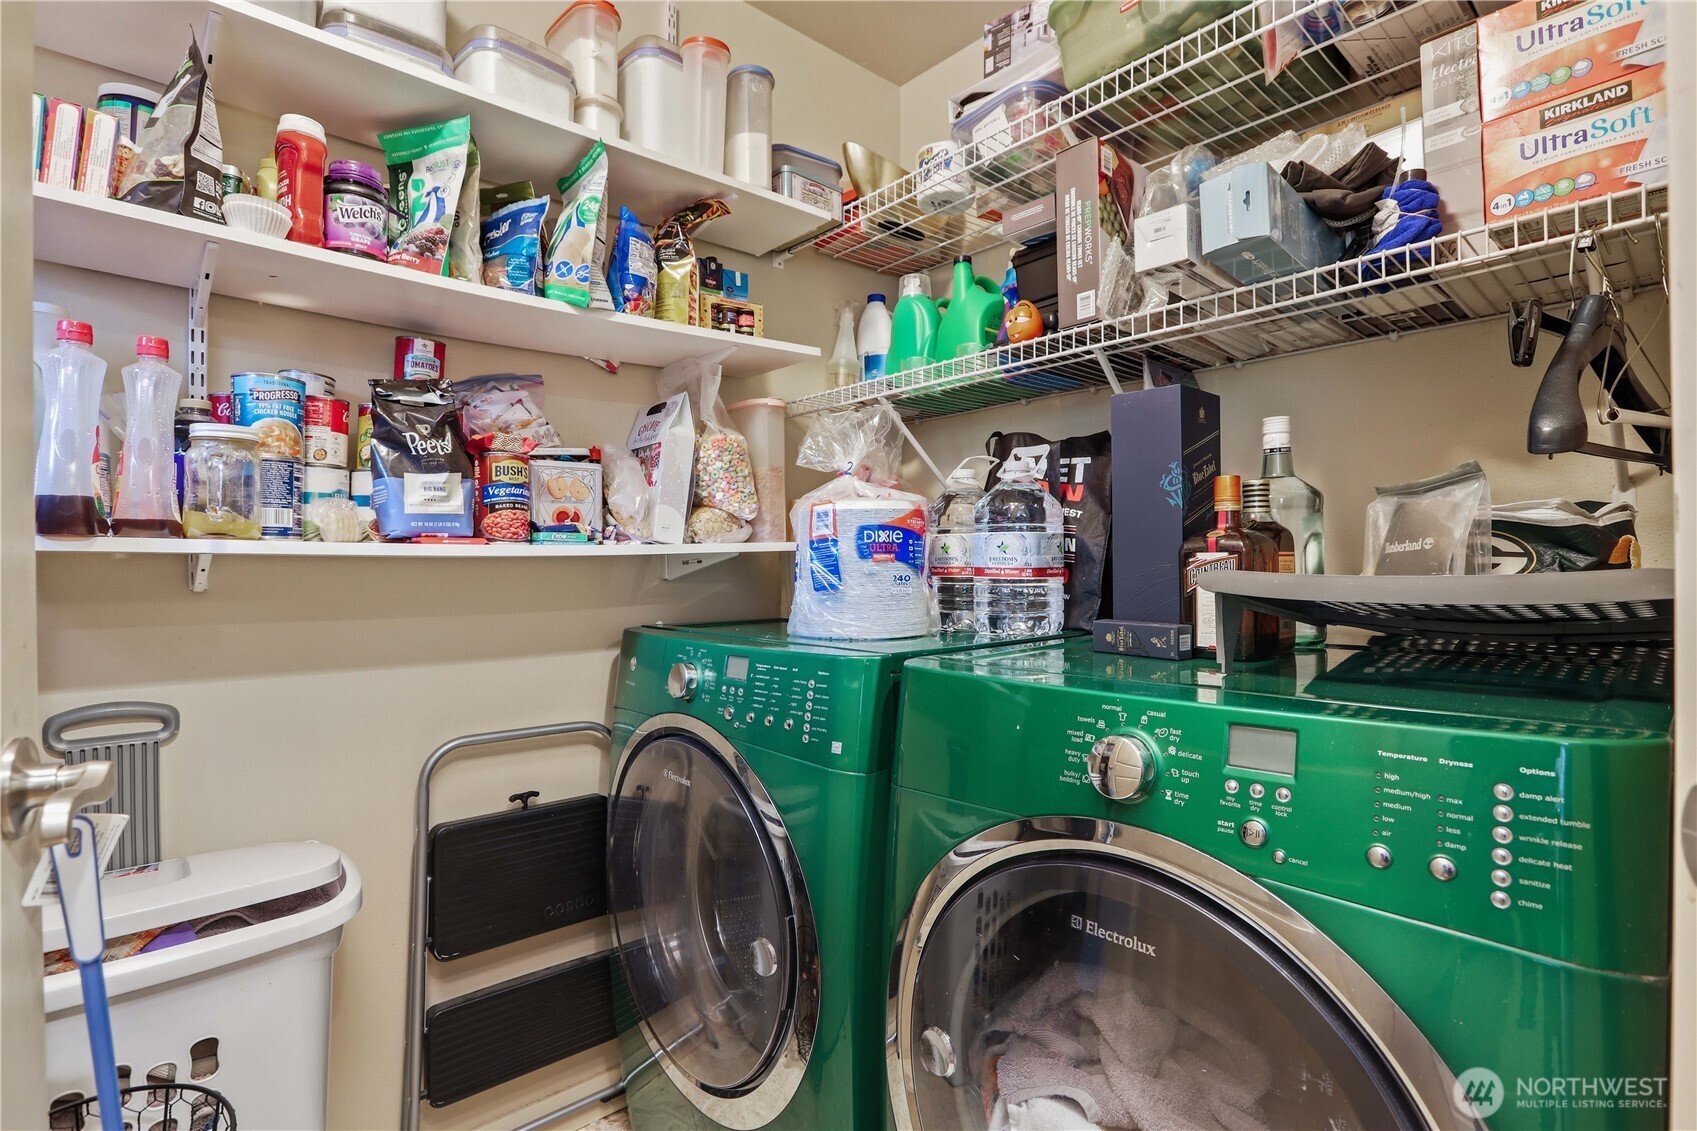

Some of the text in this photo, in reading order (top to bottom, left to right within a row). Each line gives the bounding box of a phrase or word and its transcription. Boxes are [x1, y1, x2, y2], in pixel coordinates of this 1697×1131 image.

[1516, 15, 1584, 52] Ultra
[1616, 35, 1666, 58] FRESH SC
[1544, 84, 1629, 120] KIRKLAND
[1520, 106, 1654, 160] Ultra Soft
[1619, 160, 1652, 174] FRESH
[340, 206, 382, 222] Welch's
[1084, 200, 1093, 263] PREPWORKS
[402, 252, 420, 264] Berry
[253, 390, 298, 400] PROGRESSO
[495, 465, 528, 479] BUSH'S
[1385, 538, 1422, 554] Timberland
[1067, 729, 1084, 737] mixed
[1169, 728, 1182, 736] fast
[1170, 734, 1180, 743] dry
[1064, 748, 1082, 757] heavy
[1178, 750, 1202, 761] delicate
[1377, 750, 1428, 763] Temperature
[1068, 755, 1080, 763] duty
[1439, 758, 1474, 769] Dryness
[1064, 769, 1081, 778] bulky/
[1182, 769, 1200, 778] touch
[1384, 772, 1400, 782] high
[1519, 767, 1556, 777] Options
[1060, 776, 1080, 785] bedding
[1174, 792, 1190, 800] time
[1383, 786, 1431, 800] medium/high
[1519, 792, 1565, 804] damp alert
[1174, 798, 1185, 806] dry
[1220, 799, 1241, 809] favorite
[1383, 801, 1412, 812] medium
[1446, 797, 1463, 805] max
[1272, 804, 1292, 813] control
[1446, 812, 1474, 822] normal
[1519, 813, 1591, 830] extended tumble
[1217, 826, 1235, 834] pause
[1446, 826, 1461, 835] less
[1445, 841, 1467, 852] damp
[1519, 834, 1583, 850] wrinkle release
[1288, 857, 1308, 866] cancel
[1518, 856, 1573, 871] delicate heat
[1519, 878, 1551, 889] sanitize
[1518, 899, 1543, 910] chime
[1086, 920, 1156, 956] Electrolux
